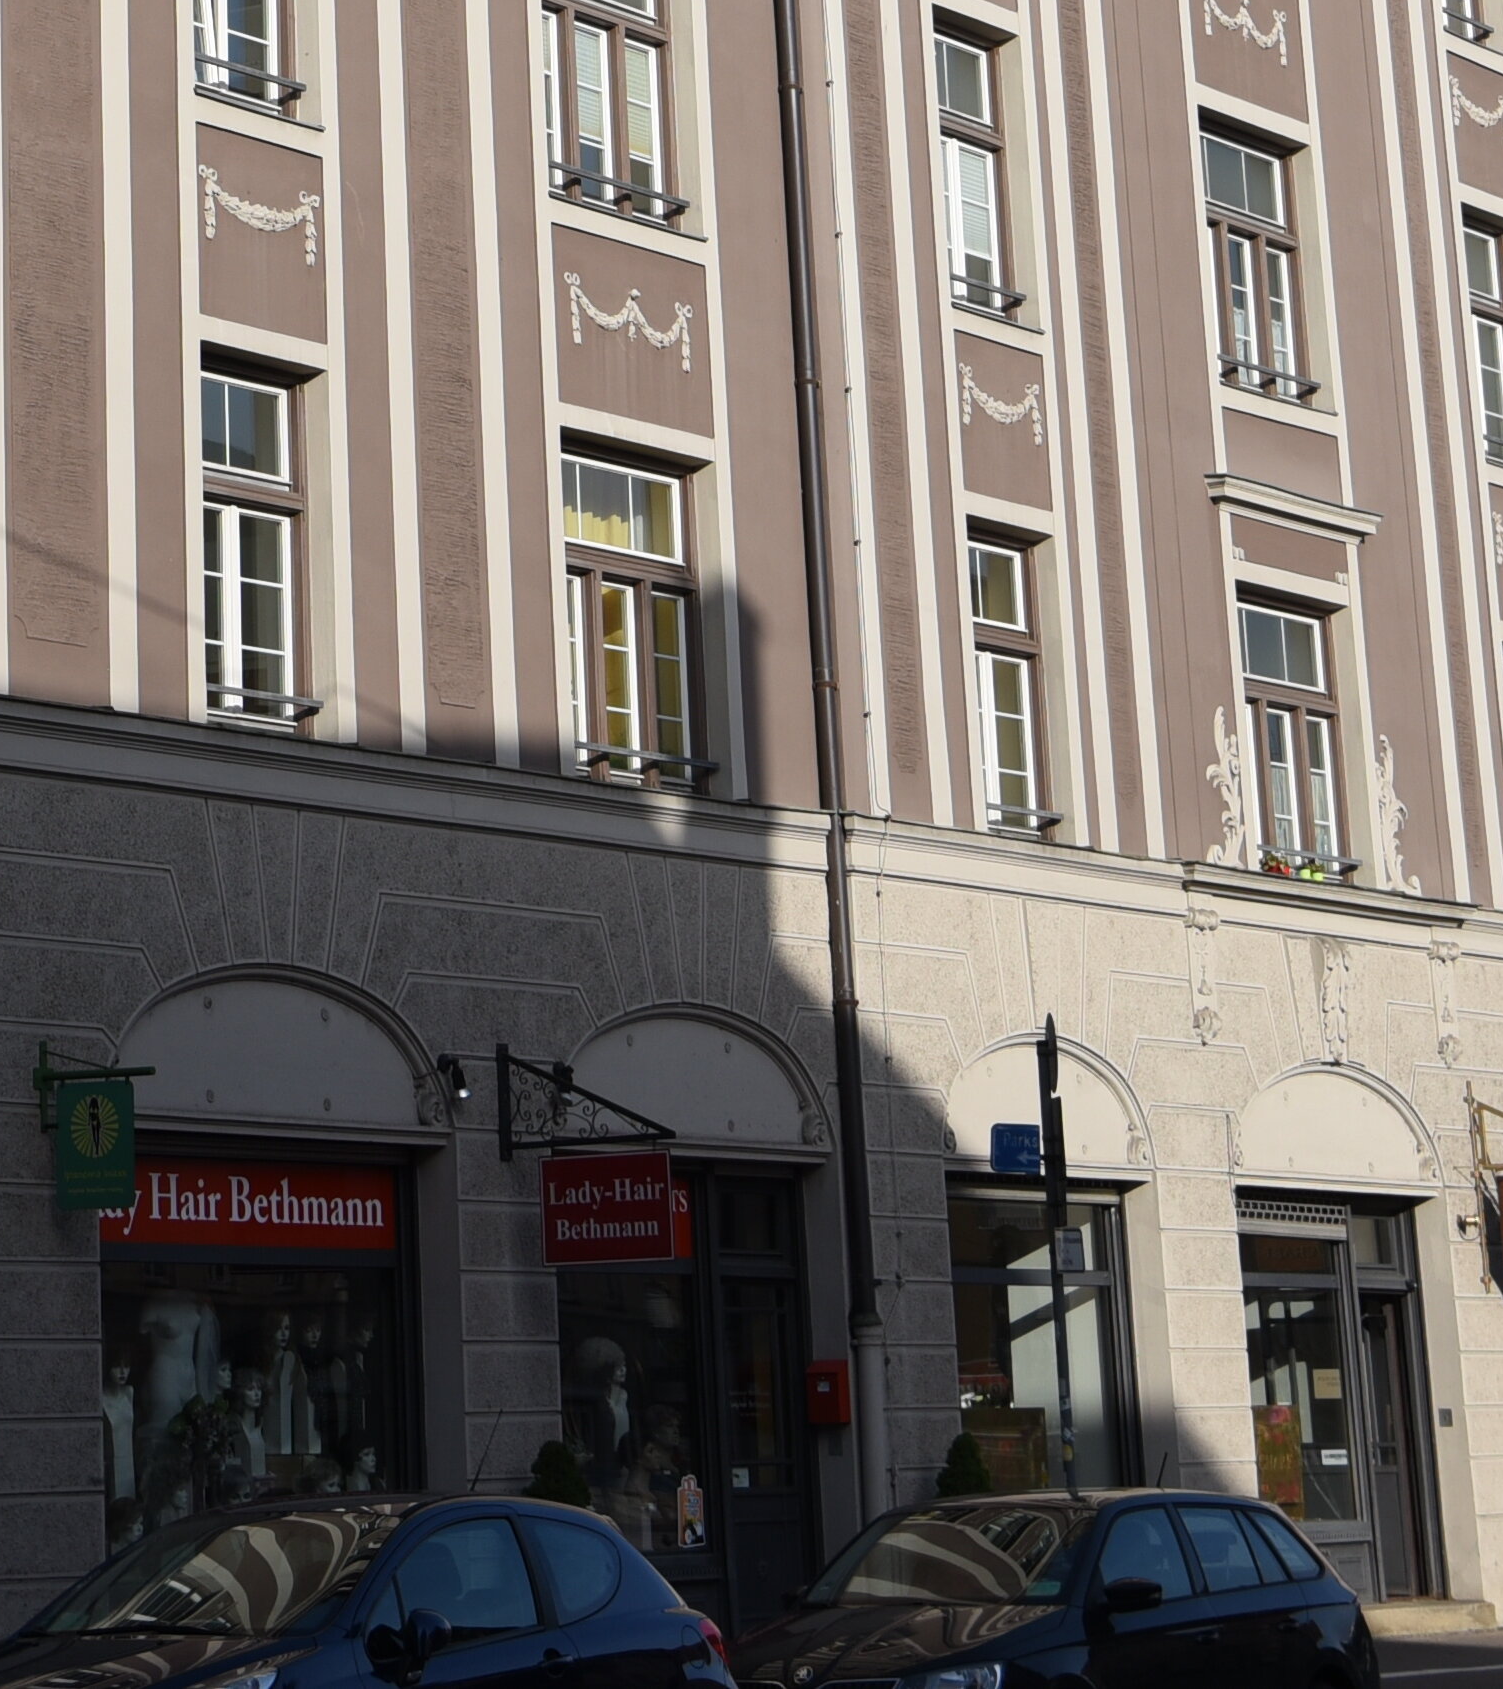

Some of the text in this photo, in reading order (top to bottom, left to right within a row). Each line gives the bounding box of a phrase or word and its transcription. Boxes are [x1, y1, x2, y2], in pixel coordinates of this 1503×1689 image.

[148, 1172, 221, 1221] Hair
[228, 1175, 384, 1227] Bethmann
[547, 1176, 665, 1209] Lady-Hair
[555, 1217, 659, 1240] Bethmann
